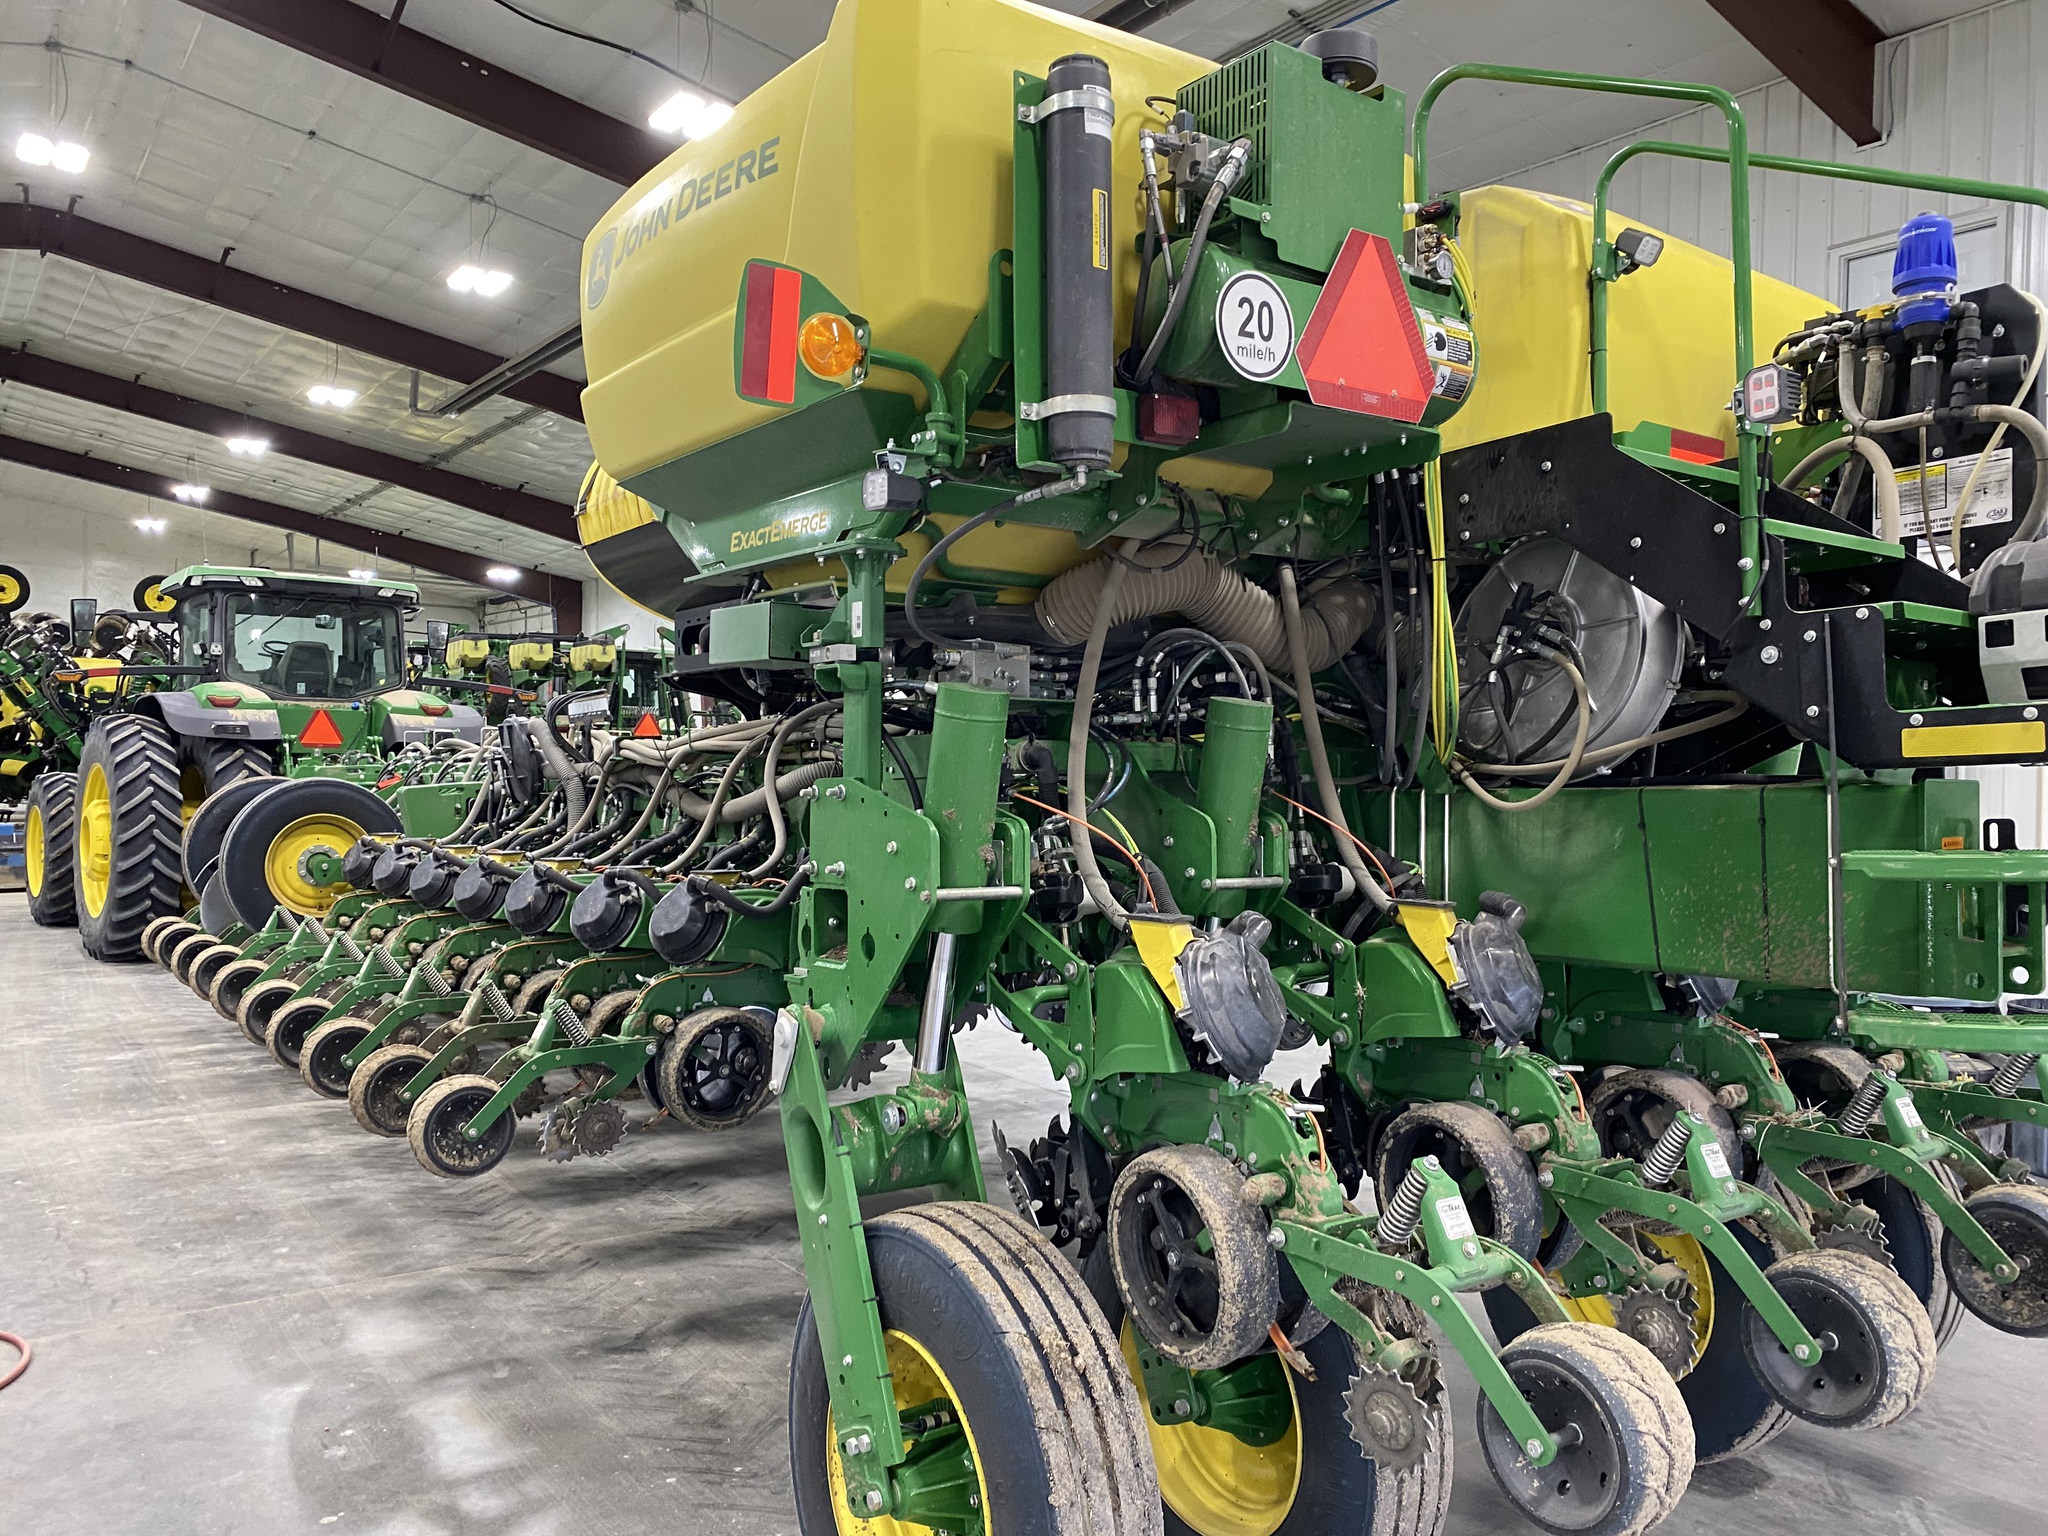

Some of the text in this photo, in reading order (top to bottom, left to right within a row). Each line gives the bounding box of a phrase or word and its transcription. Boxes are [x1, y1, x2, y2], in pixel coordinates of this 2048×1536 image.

[614, 135, 781, 269] JOHN DEERE
[1237, 296, 1274, 342] 20
[1237, 344, 1276, 362] mile/h
